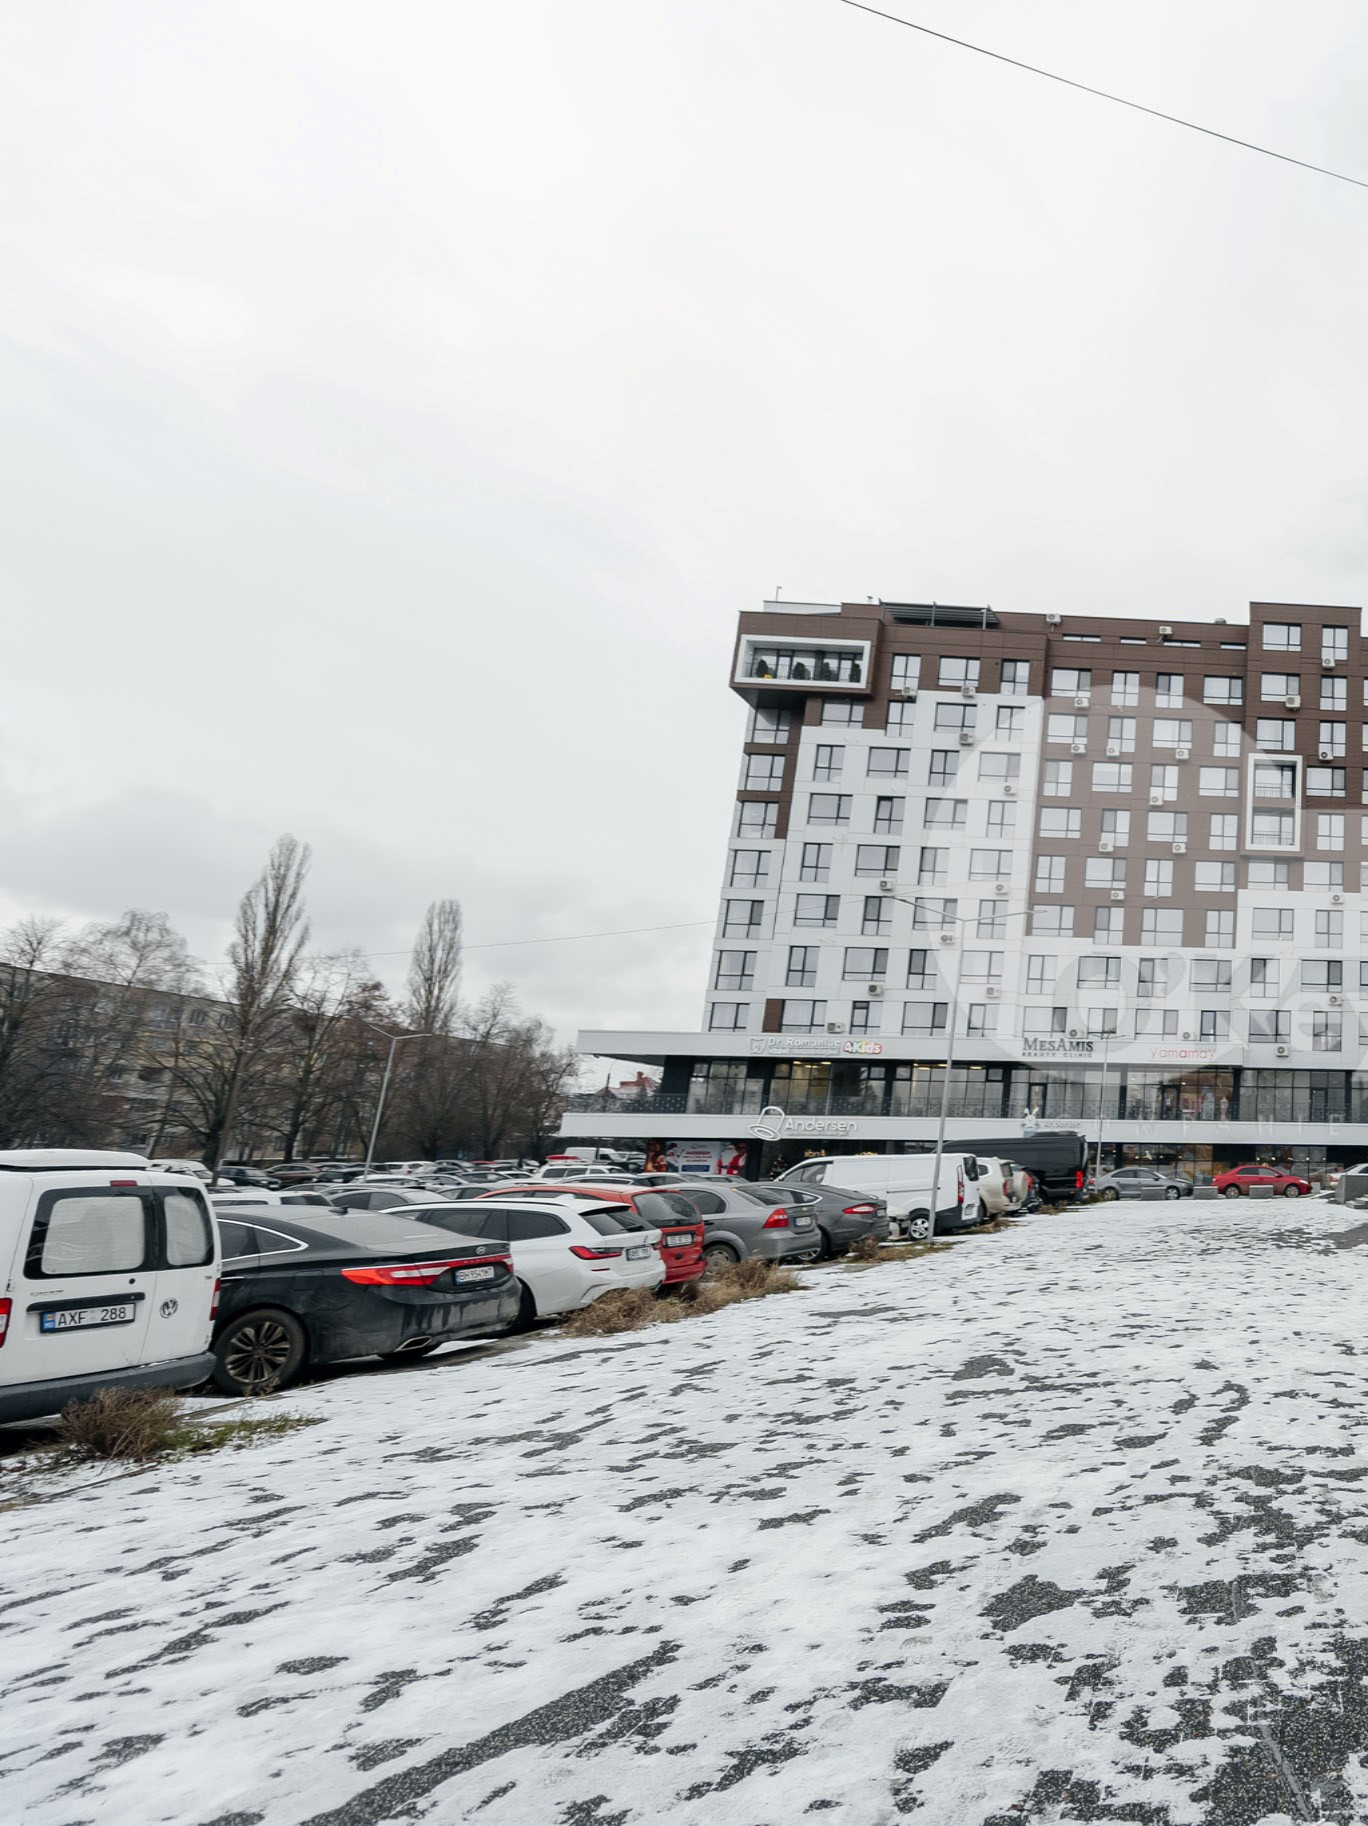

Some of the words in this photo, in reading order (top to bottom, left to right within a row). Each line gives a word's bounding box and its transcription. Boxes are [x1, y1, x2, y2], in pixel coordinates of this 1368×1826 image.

[843, 1040, 883, 1054] 4Kids
[785, 1118, 858, 1132] Andersen
[57, 1310, 88, 1326] AXF
[101, 1307, 127, 1322] 288
